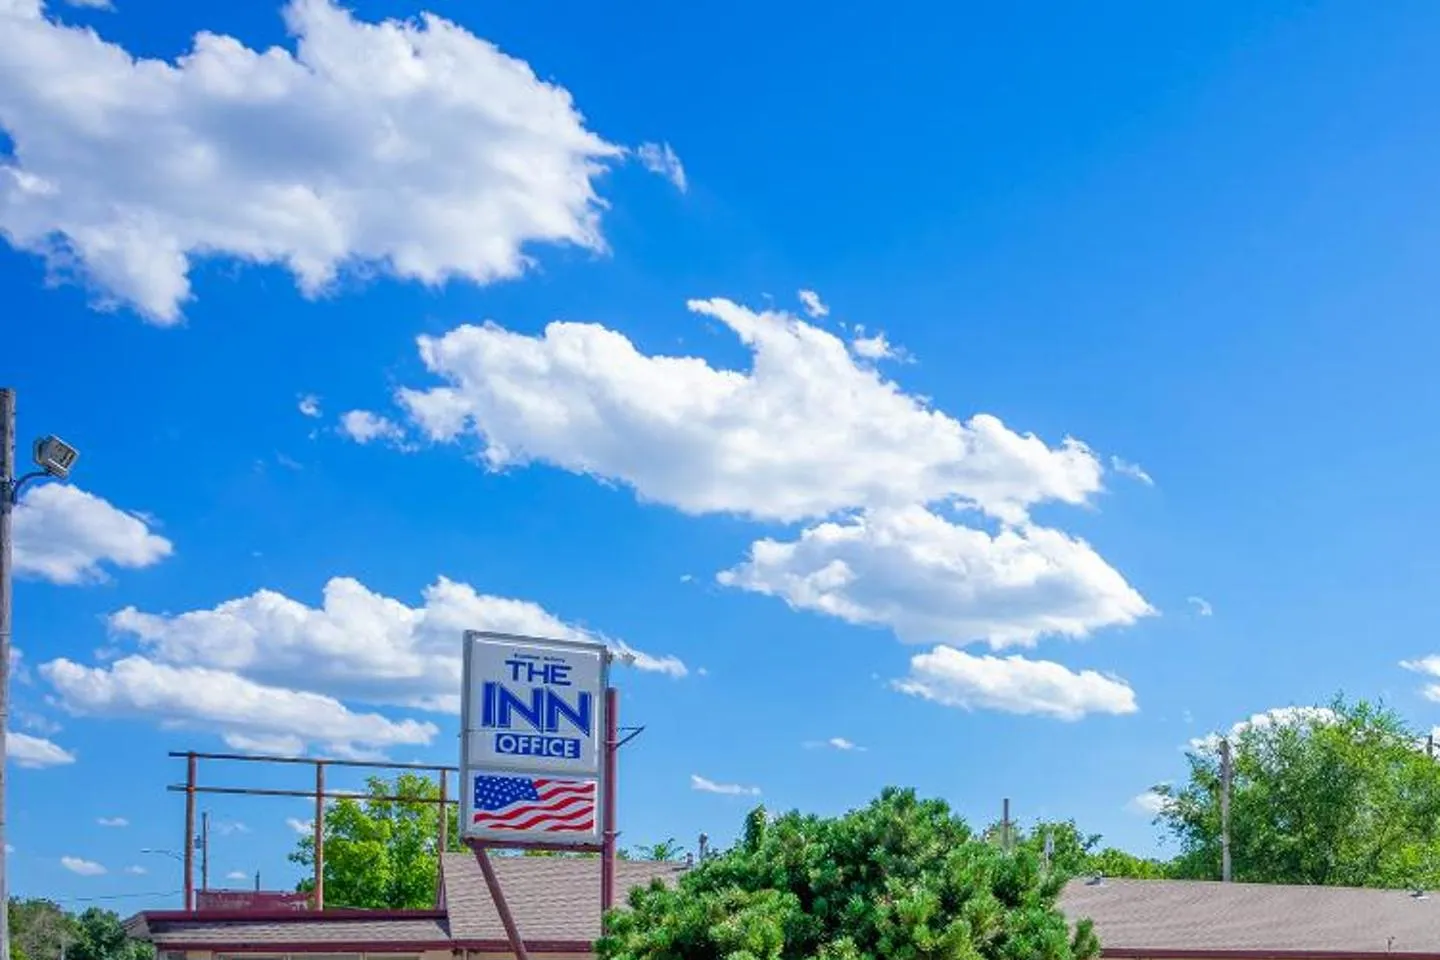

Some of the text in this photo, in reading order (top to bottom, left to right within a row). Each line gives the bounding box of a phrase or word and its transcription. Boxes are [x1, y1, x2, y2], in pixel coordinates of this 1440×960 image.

[505, 660, 572, 686] THE
[481, 681, 592, 737] INN
[498, 734, 575, 757] OFFICE
